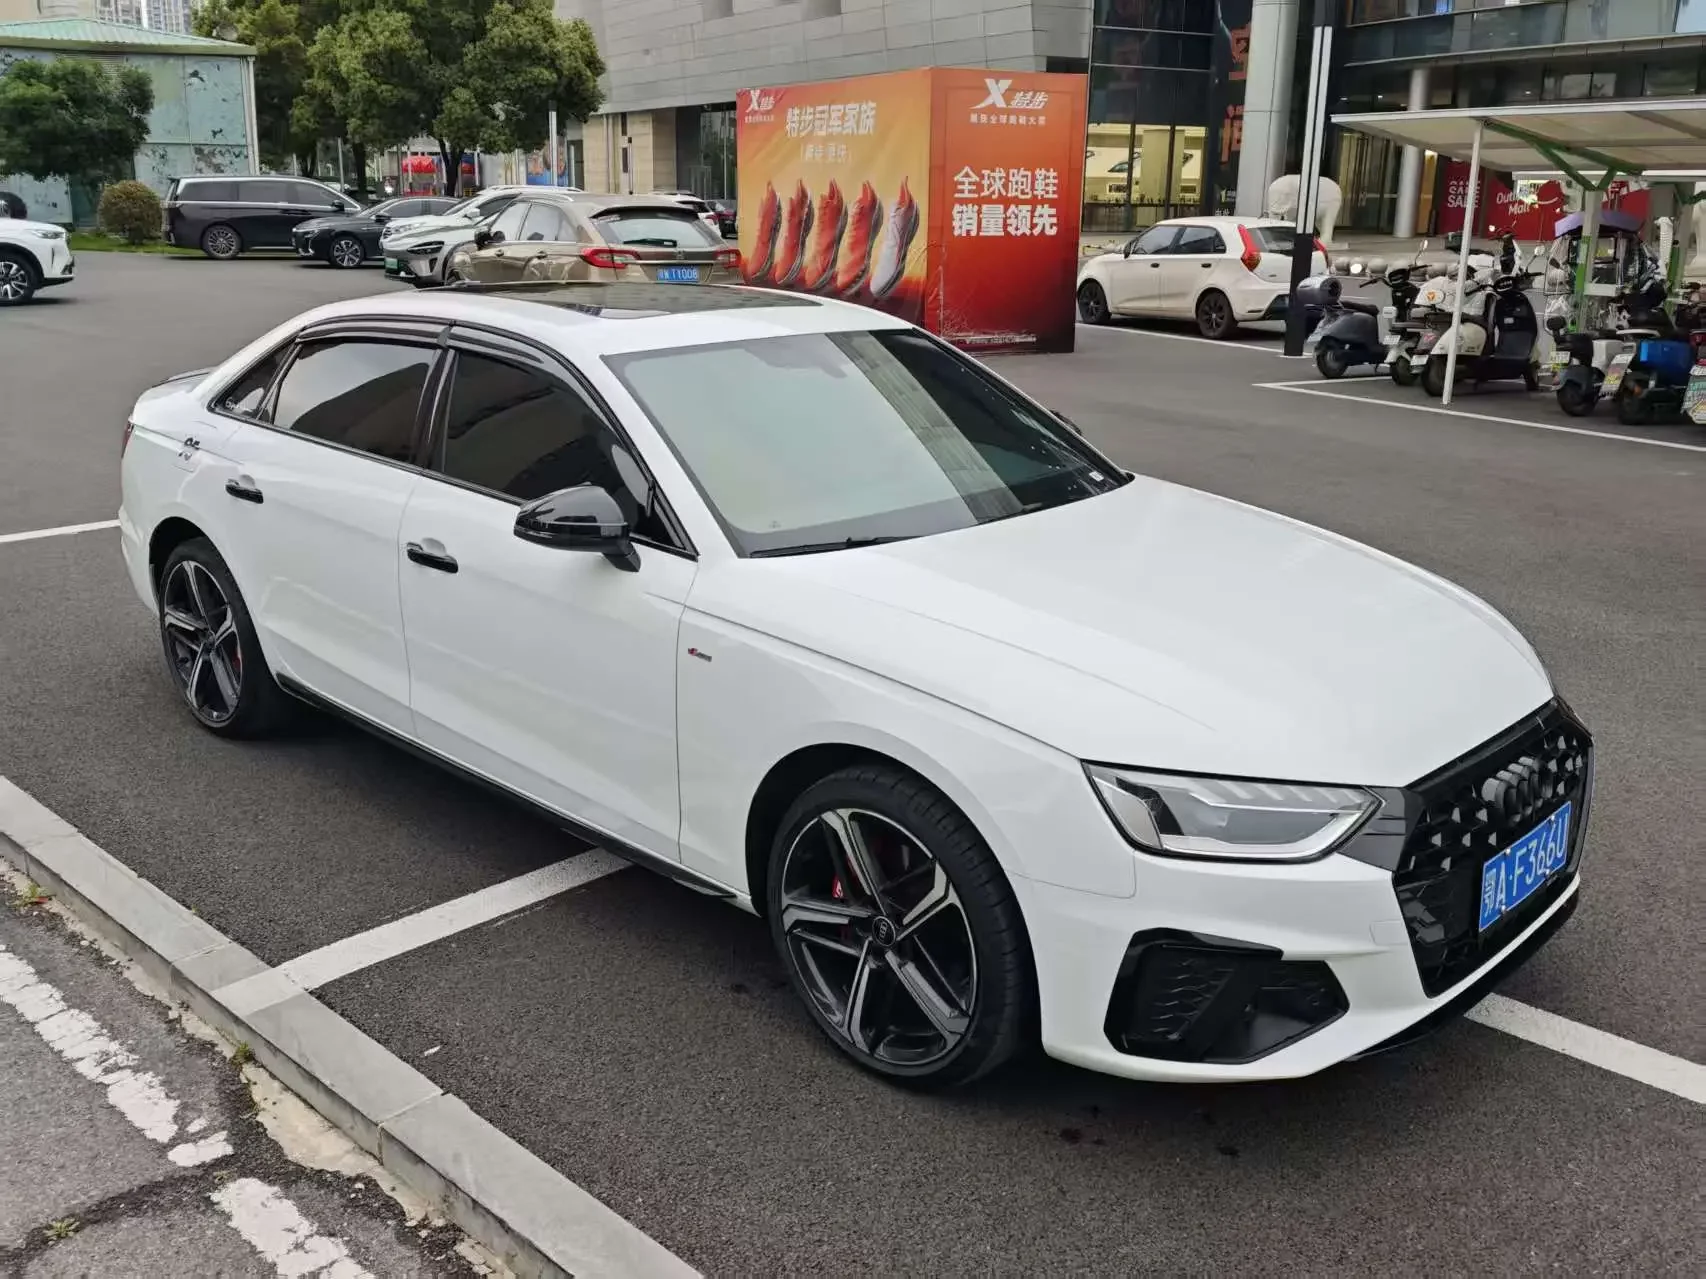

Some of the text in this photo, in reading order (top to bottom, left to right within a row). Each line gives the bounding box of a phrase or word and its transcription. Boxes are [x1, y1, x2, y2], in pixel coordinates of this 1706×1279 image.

[954, 166, 1058, 199] 全球跑鞋
[952, 203, 1058, 236] 销量领先
